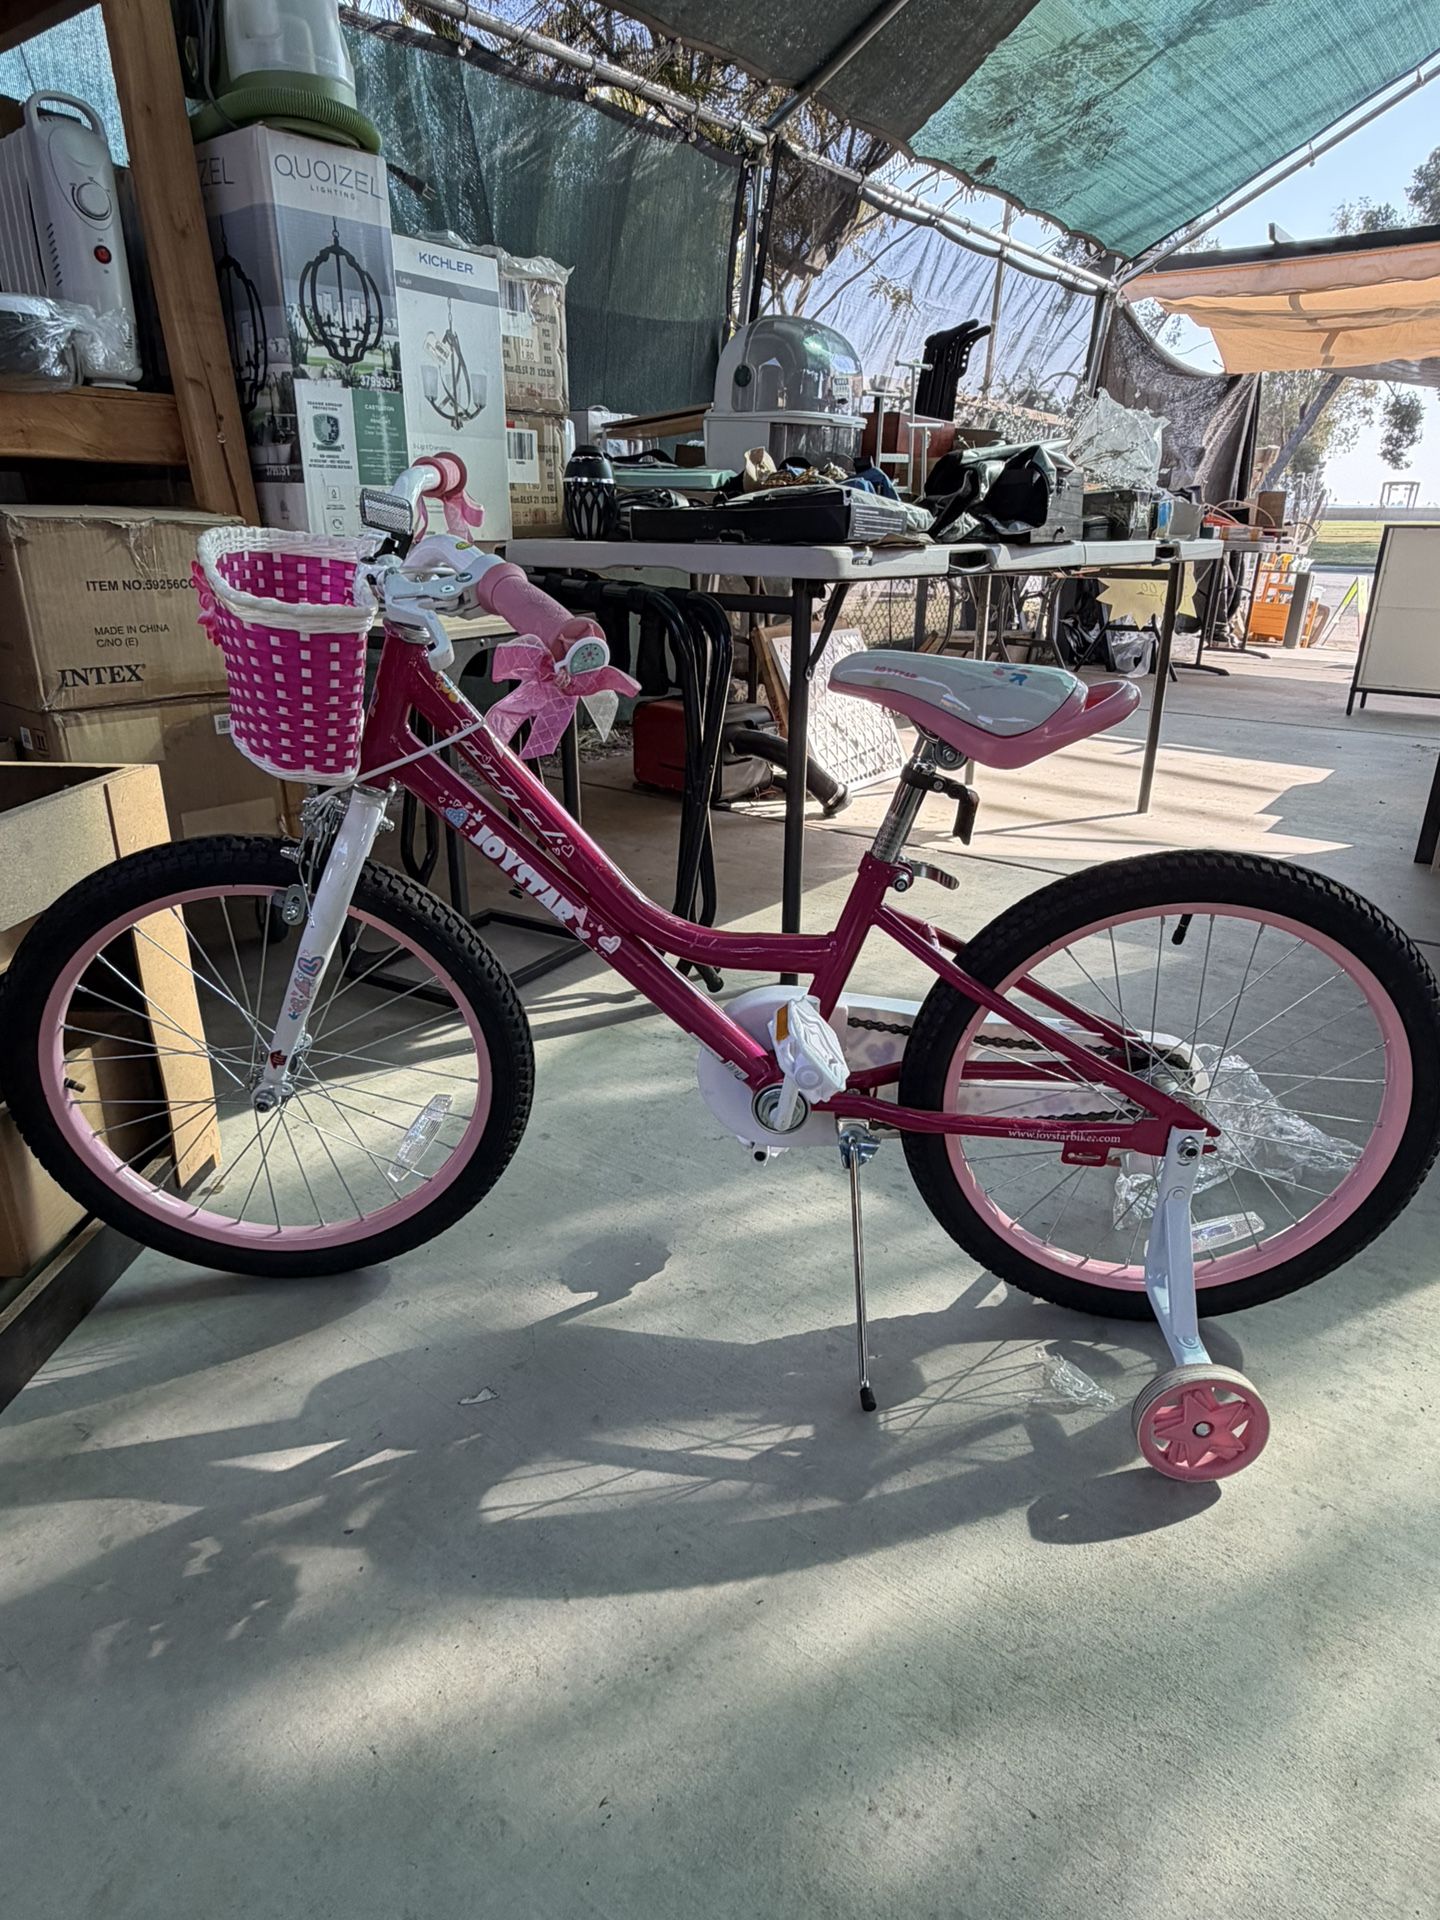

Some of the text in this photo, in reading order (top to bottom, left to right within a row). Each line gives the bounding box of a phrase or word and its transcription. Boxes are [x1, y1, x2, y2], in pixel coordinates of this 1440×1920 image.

[197, 158, 235, 187] ZEL
[274, 154, 384, 200] QUOIZEL
[310, 185, 356, 201] LIGHTING
[418, 252, 474, 275] KICHLER
[360, 375, 395, 389] 3799351
[86, 580, 119, 592] ITEM
[94, 623, 170, 636] MADE IN CHINA
[96, 637, 139, 648] C/NO (E)
[57, 664, 144, 688] INTEX
[468, 824, 577, 923] JOYSTAR
